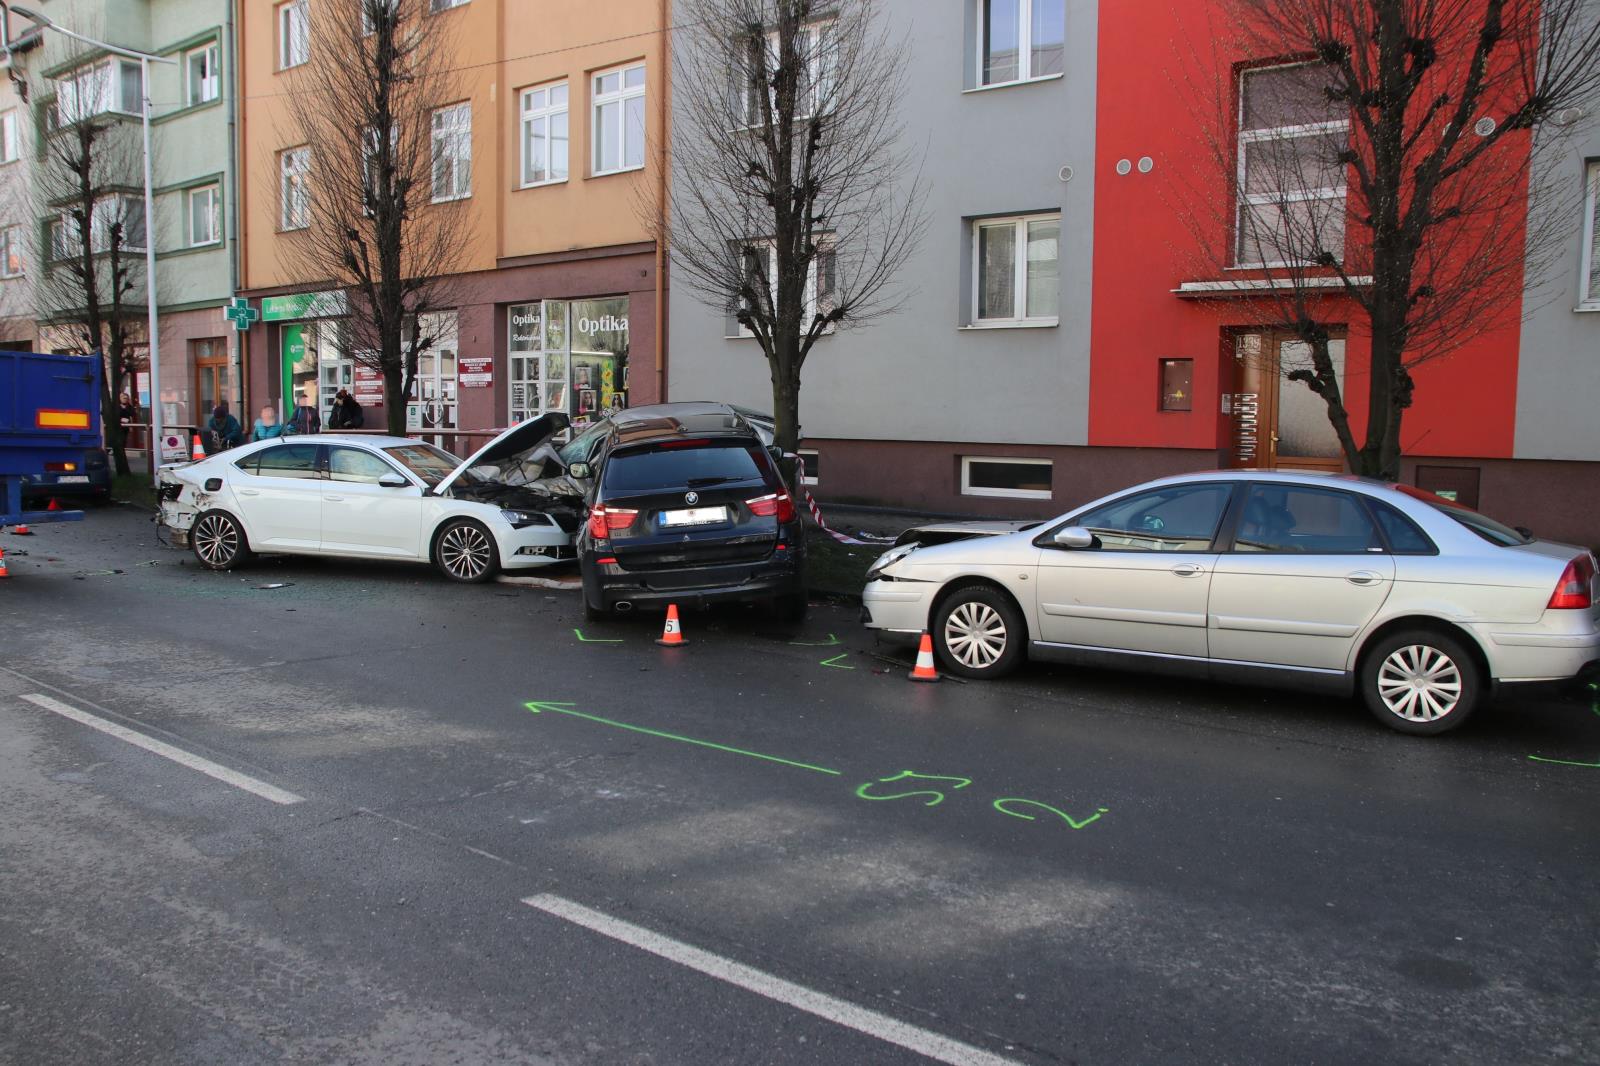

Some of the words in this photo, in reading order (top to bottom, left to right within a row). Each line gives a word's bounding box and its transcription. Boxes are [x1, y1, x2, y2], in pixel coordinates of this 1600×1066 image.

[512, 313, 541, 326] Optika
[578, 315, 629, 336] Optika
[666, 620, 674, 633] 5
